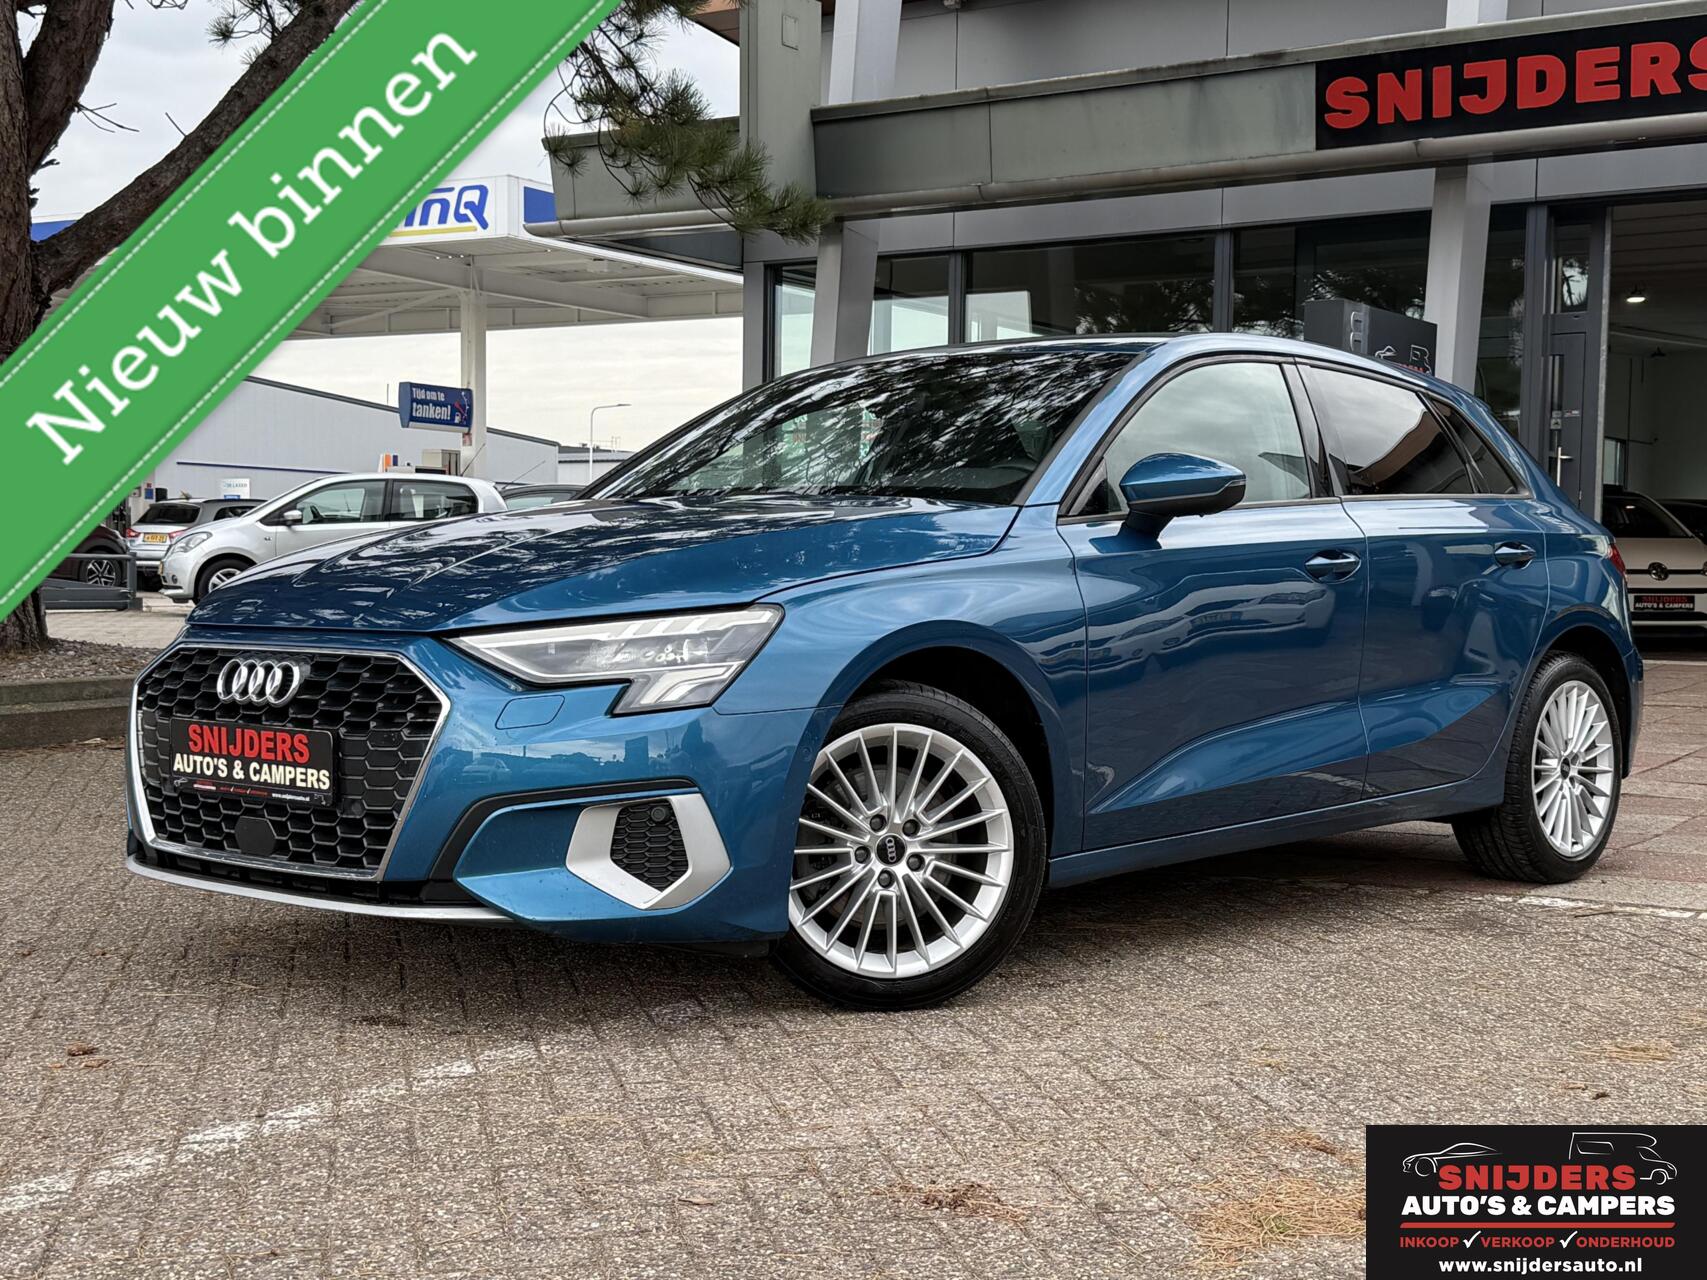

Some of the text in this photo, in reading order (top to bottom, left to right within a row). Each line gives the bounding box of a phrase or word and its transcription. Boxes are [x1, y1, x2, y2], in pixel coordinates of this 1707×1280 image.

[412, 387, 446, 402] Tijd om te
[412, 402, 451, 420] tanken!
[188, 724, 310, 764] SNIJDERS
[173, 753, 330, 790] AUTO'S & CAMPERS
